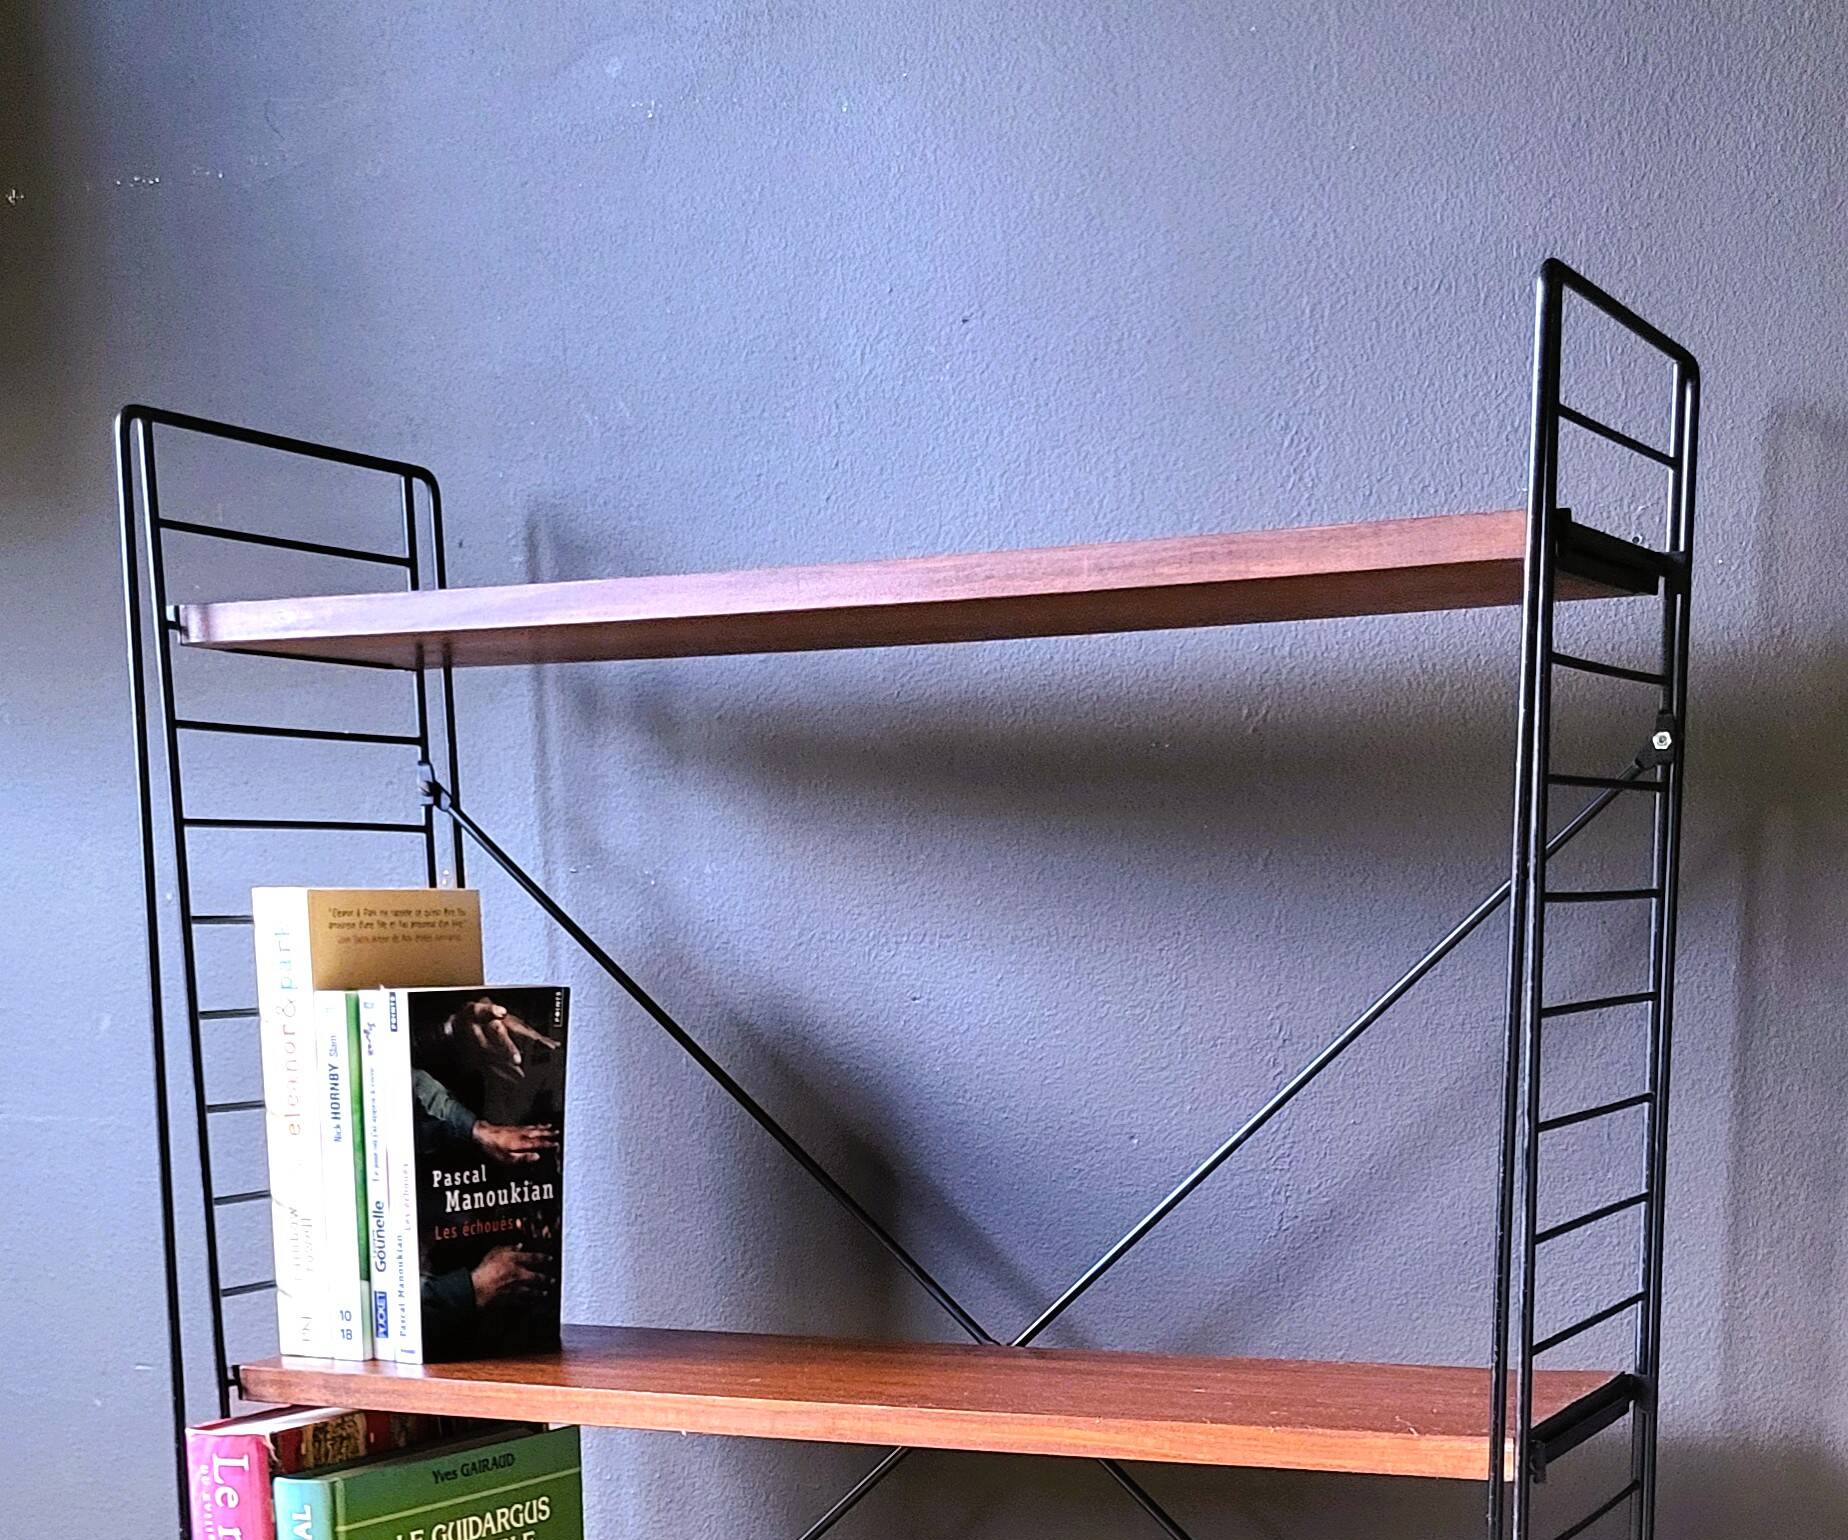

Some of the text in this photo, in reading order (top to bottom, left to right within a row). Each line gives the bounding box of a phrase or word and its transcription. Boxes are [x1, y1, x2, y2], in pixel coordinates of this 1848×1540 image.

[328, 1063, 342, 1120] HORNBY
[432, 1164, 487, 1188] Pascal
[445, 1180, 554, 1213] Manoukian
[372, 1200, 387, 1272] Gounelle
[434, 1215, 513, 1240] Les échoués
[339, 1309, 352, 1322] 10
[340, 1328, 353, 1341] 18
[211, 1453, 249, 1510] Le
[432, 1453, 516, 1484] Yves GAIRAUD
